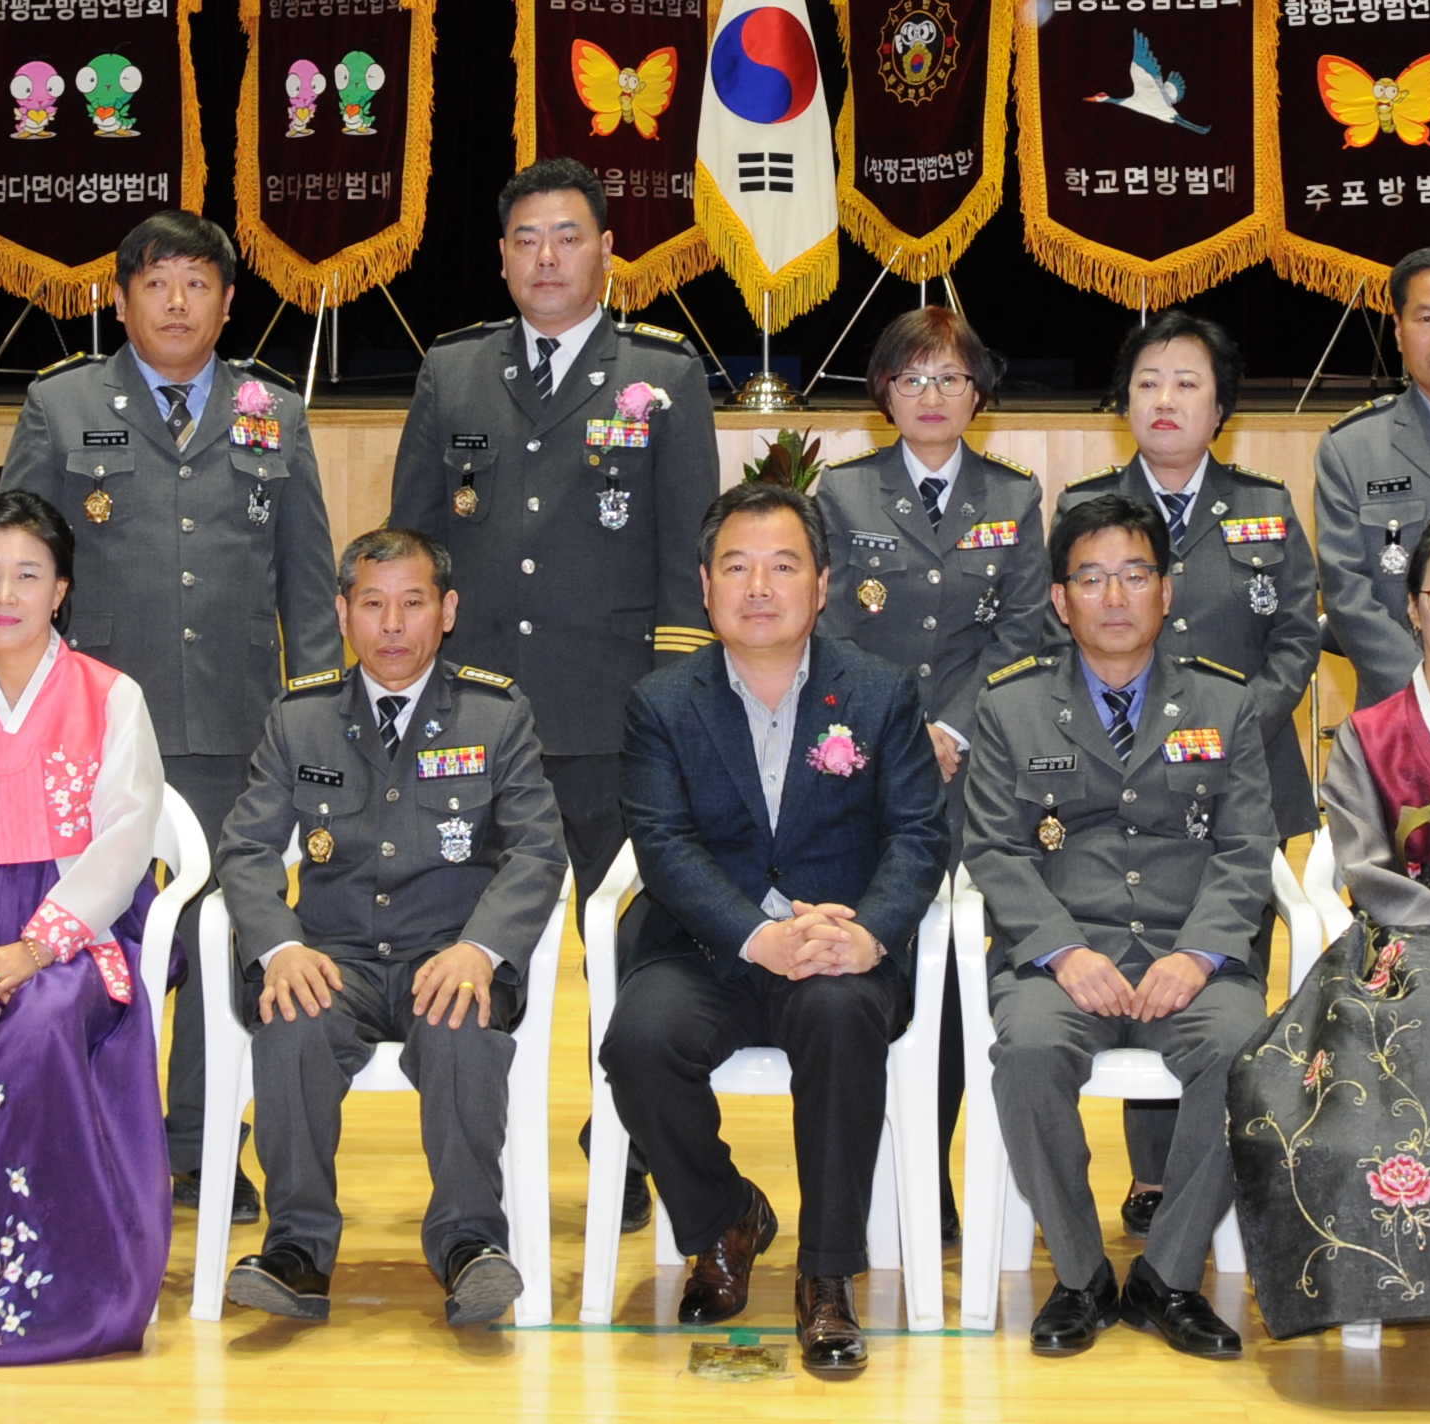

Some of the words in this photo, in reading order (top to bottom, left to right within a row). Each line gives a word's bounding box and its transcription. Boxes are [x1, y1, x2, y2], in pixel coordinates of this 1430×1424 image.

[266, 170, 392, 203] 엄다면방범대
[602, 167, 695, 199] 읍방범대
[1064, 165, 1236, 196] 학교면방범대
